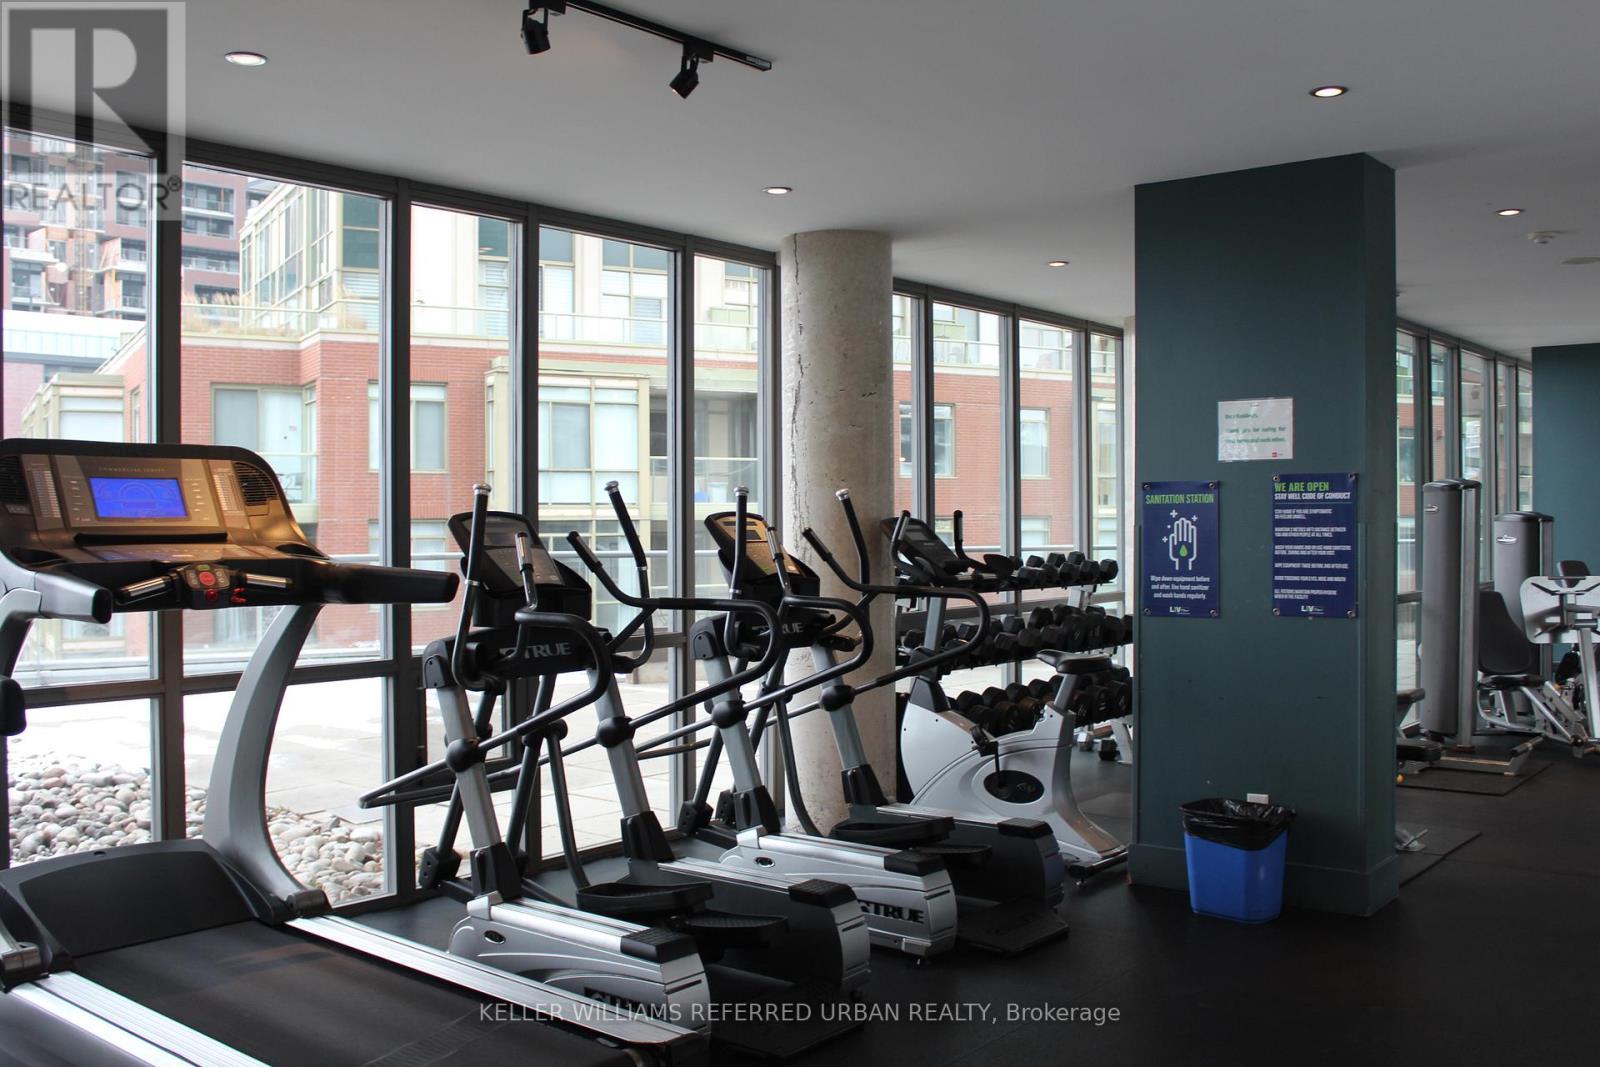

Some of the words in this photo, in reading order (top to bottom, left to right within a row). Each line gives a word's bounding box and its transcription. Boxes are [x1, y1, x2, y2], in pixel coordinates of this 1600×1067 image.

[1274, 482, 1286, 492] WE
[1289, 482, 1305, 492] ARE
[1307, 481, 1330, 492] OPEN
[1145, 494, 1185, 505] SANITATION
[1186, 493, 1215, 504] STATION
[1274, 492, 1287, 500] STAY
[1301, 492, 1316, 500] CODE
[1325, 491, 1351, 499] CONDUCT
[524, 641, 572, 659] TRUE
